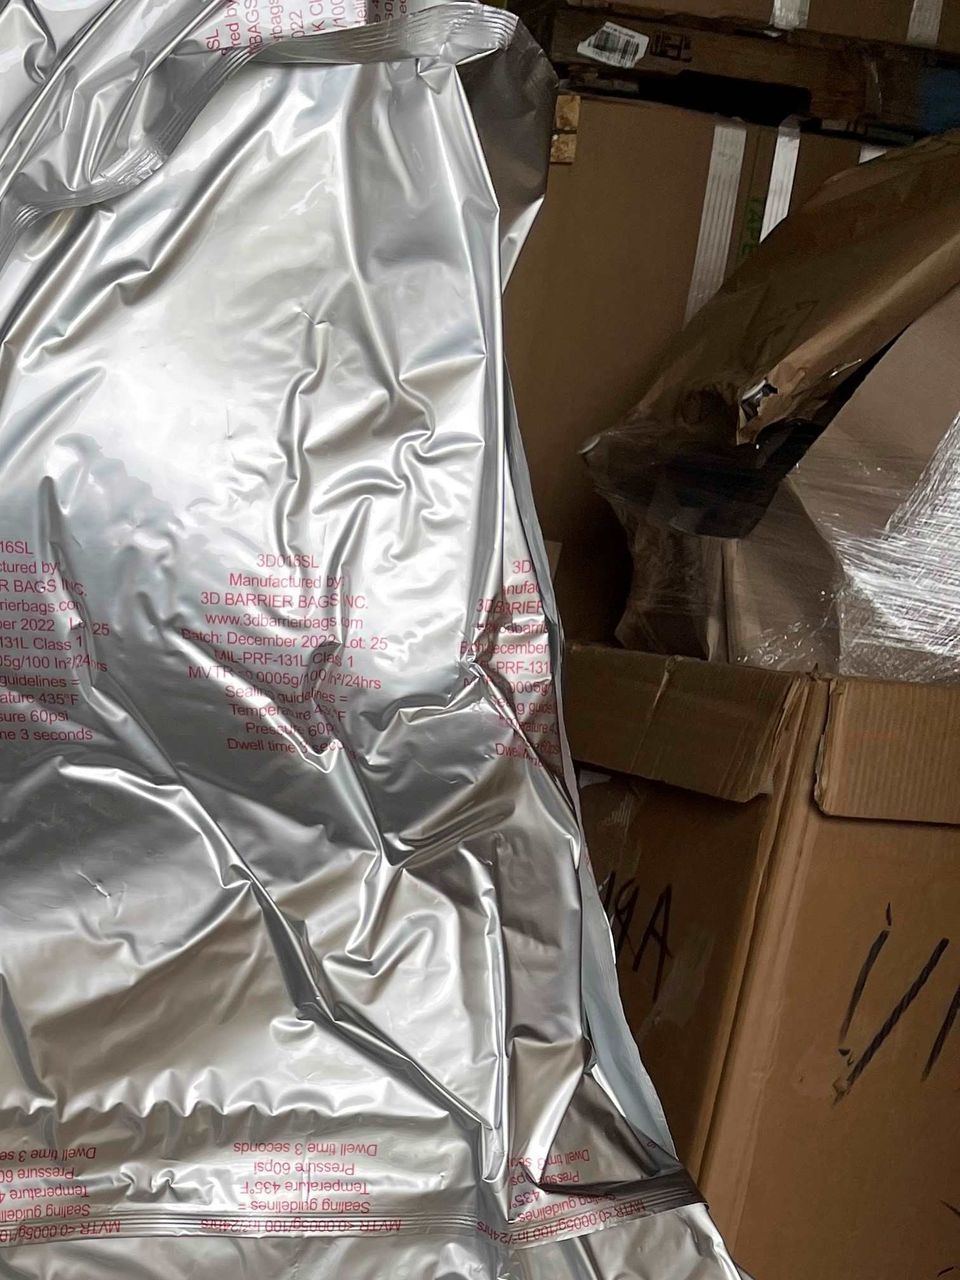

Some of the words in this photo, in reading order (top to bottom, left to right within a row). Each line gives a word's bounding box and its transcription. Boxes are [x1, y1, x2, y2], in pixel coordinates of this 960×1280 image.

[13, 577, 56, 593] BAGS
[200, 592, 220, 605] 3D
[224, 593, 293, 607] BARRIER
[21, 616, 55, 632] 2022
[33, 635, 72, 651] Class
[76, 636, 82, 651] 1
[370, 637, 388, 650] 25
[0, 672, 67, 690] guidelines
[30, 708, 69, 727] 60psi
[20, 726, 29, 741] 3
[33, 727, 93, 742] seconds
[233, 1143, 290, 1155] seconds
[295, 1144, 303, 1155] 3
[307, 1144, 336, 1155] time
[340, 1144, 378, 1156] Dwell
[17, 1168, 74, 1179] Pressure
[253, 1160, 291, 1174] 60psi
[10, 1185, 89, 1200] Temperature
[46, 1205, 91, 1218] Sealing
